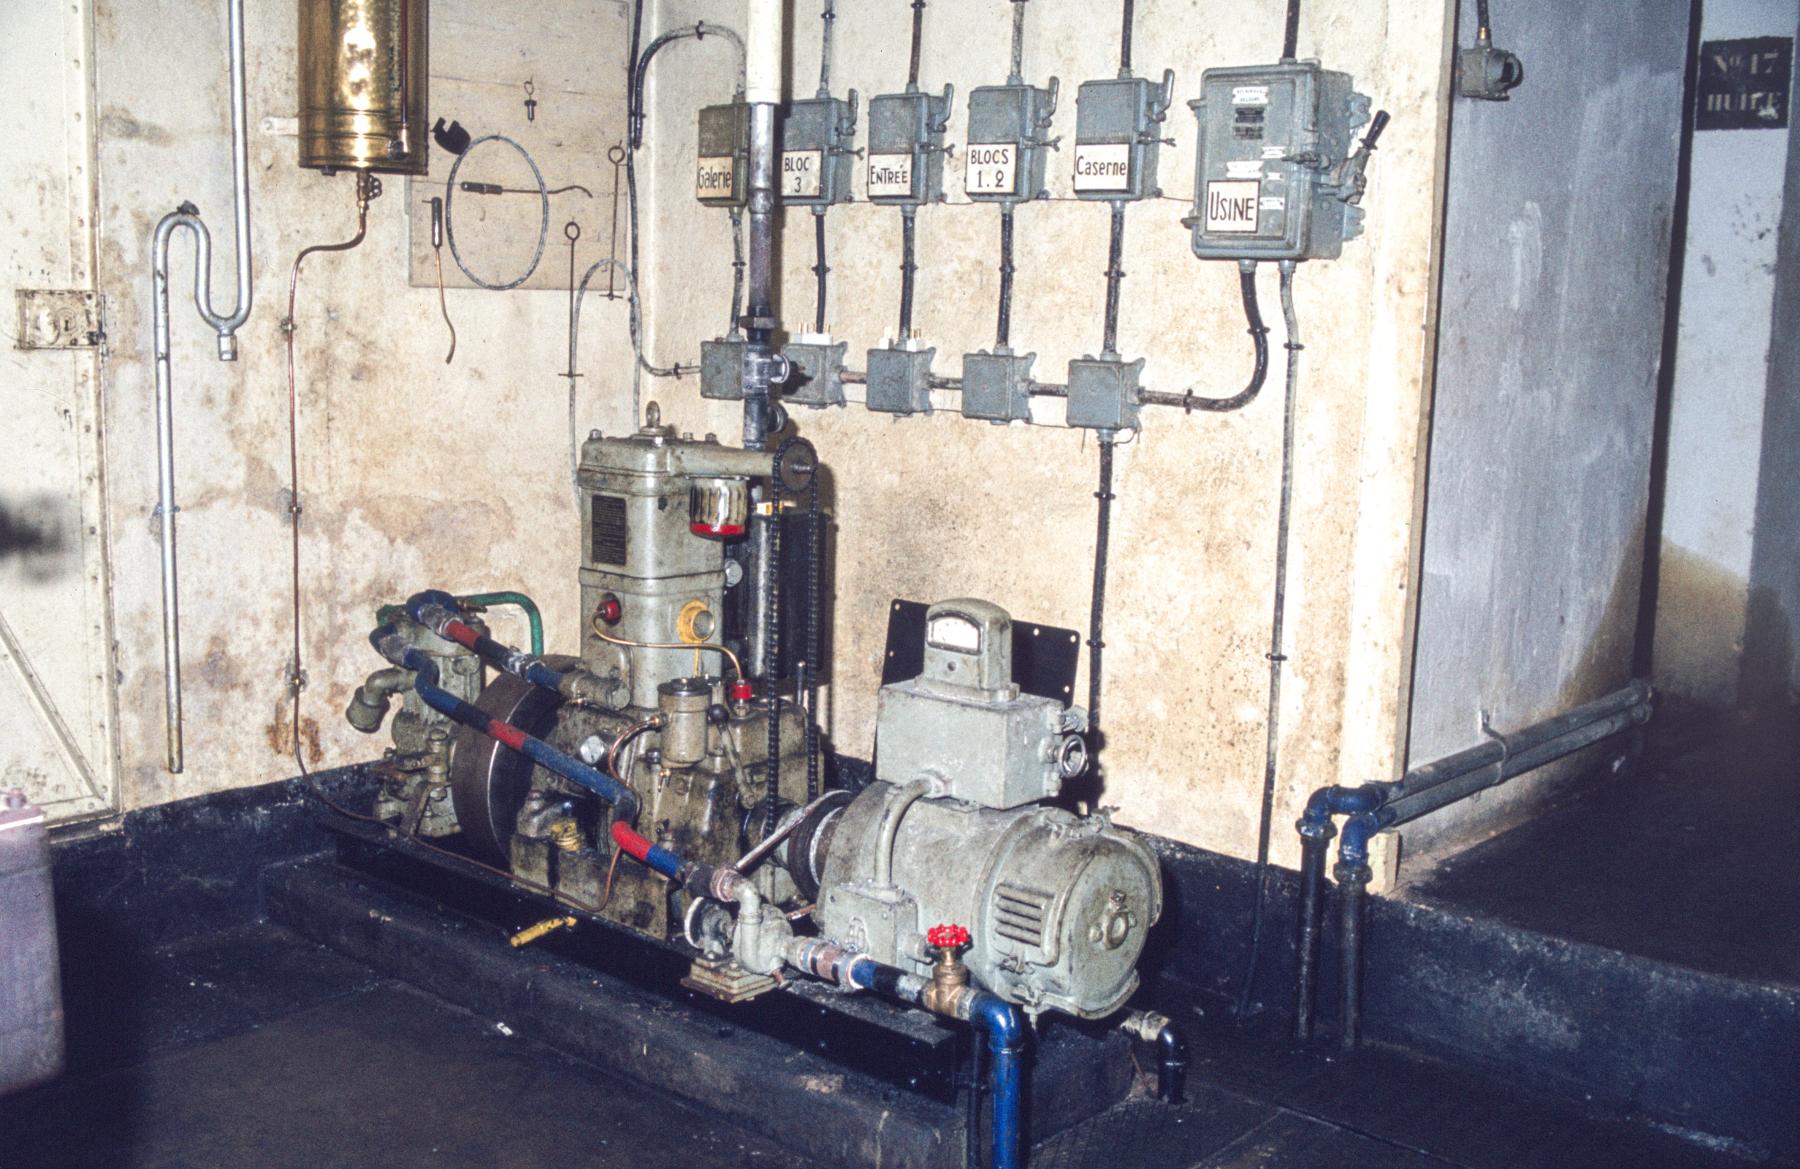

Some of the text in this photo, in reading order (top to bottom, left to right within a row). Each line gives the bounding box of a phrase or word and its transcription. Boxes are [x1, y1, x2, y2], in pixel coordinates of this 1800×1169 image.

[784, 157, 809, 171] BLOC
[971, 149, 1009, 164] BLOCS
[1077, 155, 1127, 176] Caserne
[698, 166, 731, 189] Galerie
[794, 177, 802, 193] 3
[1210, 191, 1255, 222] USINE
